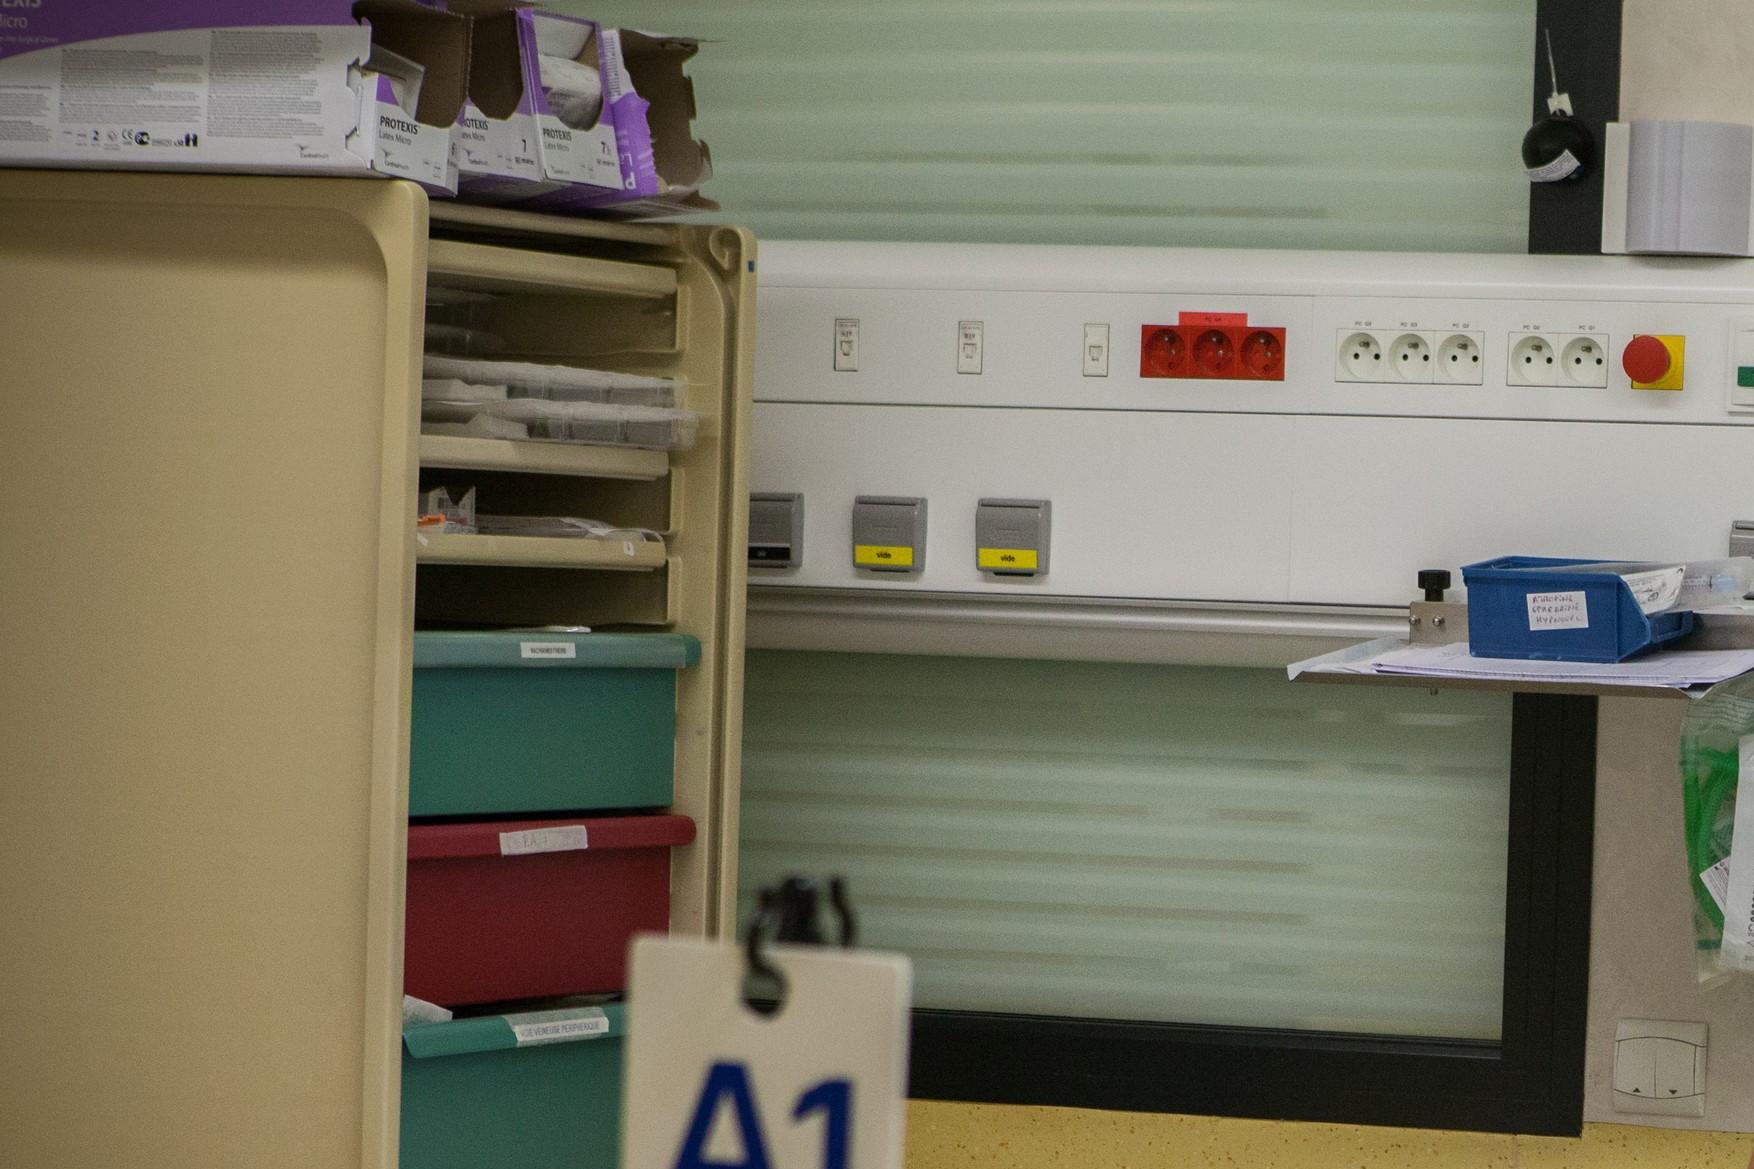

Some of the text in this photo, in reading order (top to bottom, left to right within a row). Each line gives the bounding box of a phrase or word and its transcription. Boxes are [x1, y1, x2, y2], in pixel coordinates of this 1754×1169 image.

[380, 115, 418, 135] PROTEXIS
[543, 127, 572, 142] PROTEXIS
[876, 551, 892, 559] vide
[1000, 554, 1015, 562] vide
